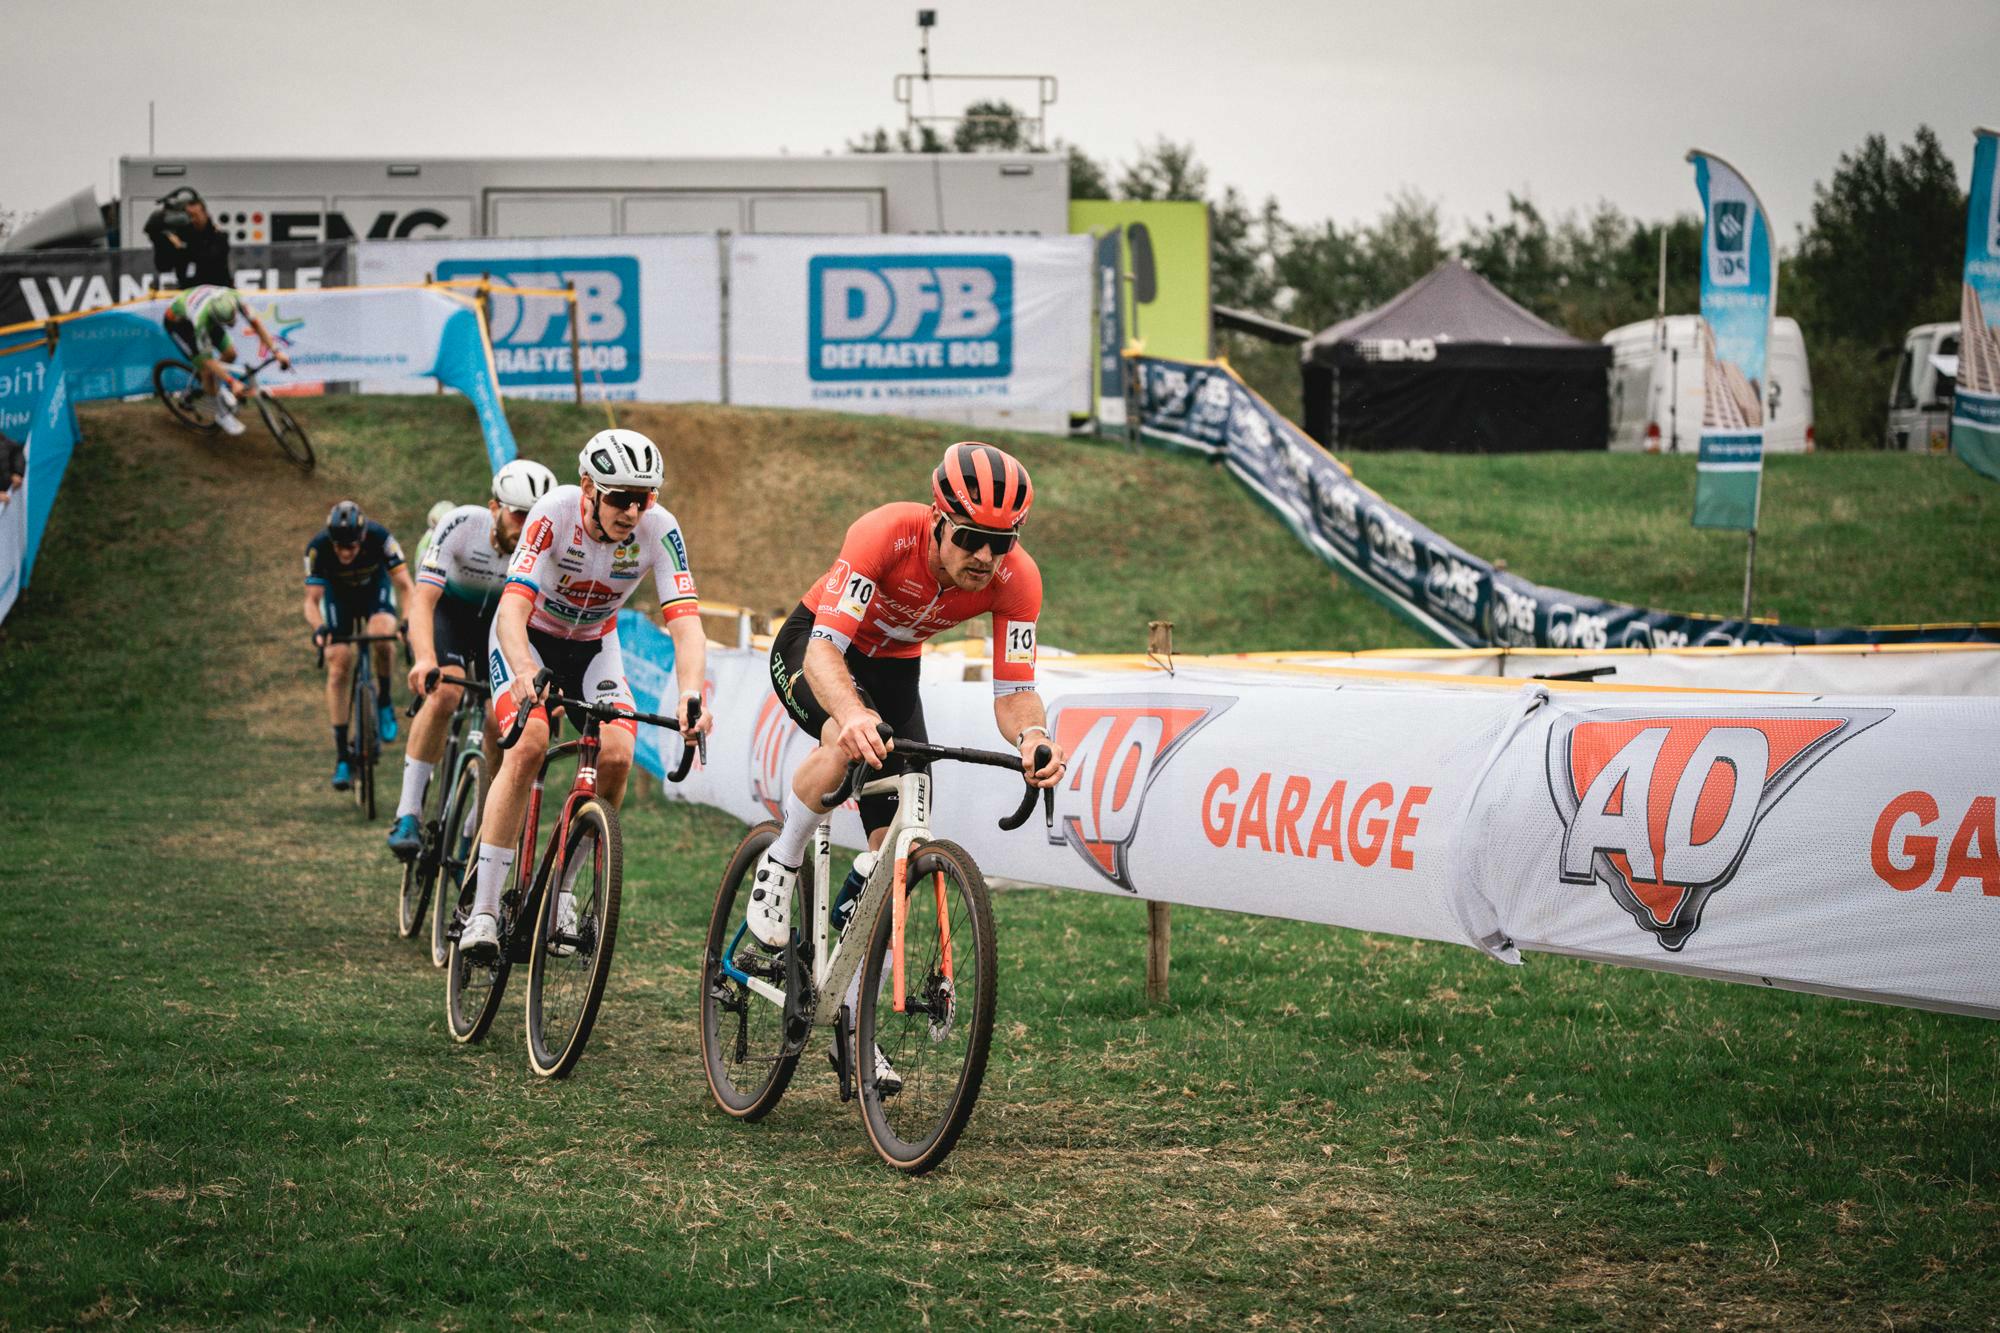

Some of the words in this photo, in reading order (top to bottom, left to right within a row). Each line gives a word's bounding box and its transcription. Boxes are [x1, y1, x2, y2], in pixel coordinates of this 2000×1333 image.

[821, 267, 1000, 340] DFB
[821, 343, 944, 370] DEFRAEYE
[948, 341, 999, 368] BOB
[531, 519, 552, 552] Pauwels
[669, 533, 688, 569] ALTEZ
[566, 546, 586, 559] Hertz
[850, 578, 873, 605] 10
[1009, 628, 1033, 650] 10
[917, 777, 926, 822] CUBE
[1201, 767, 1434, 871] GARAGE
[820, 841, 830, 855] 2
